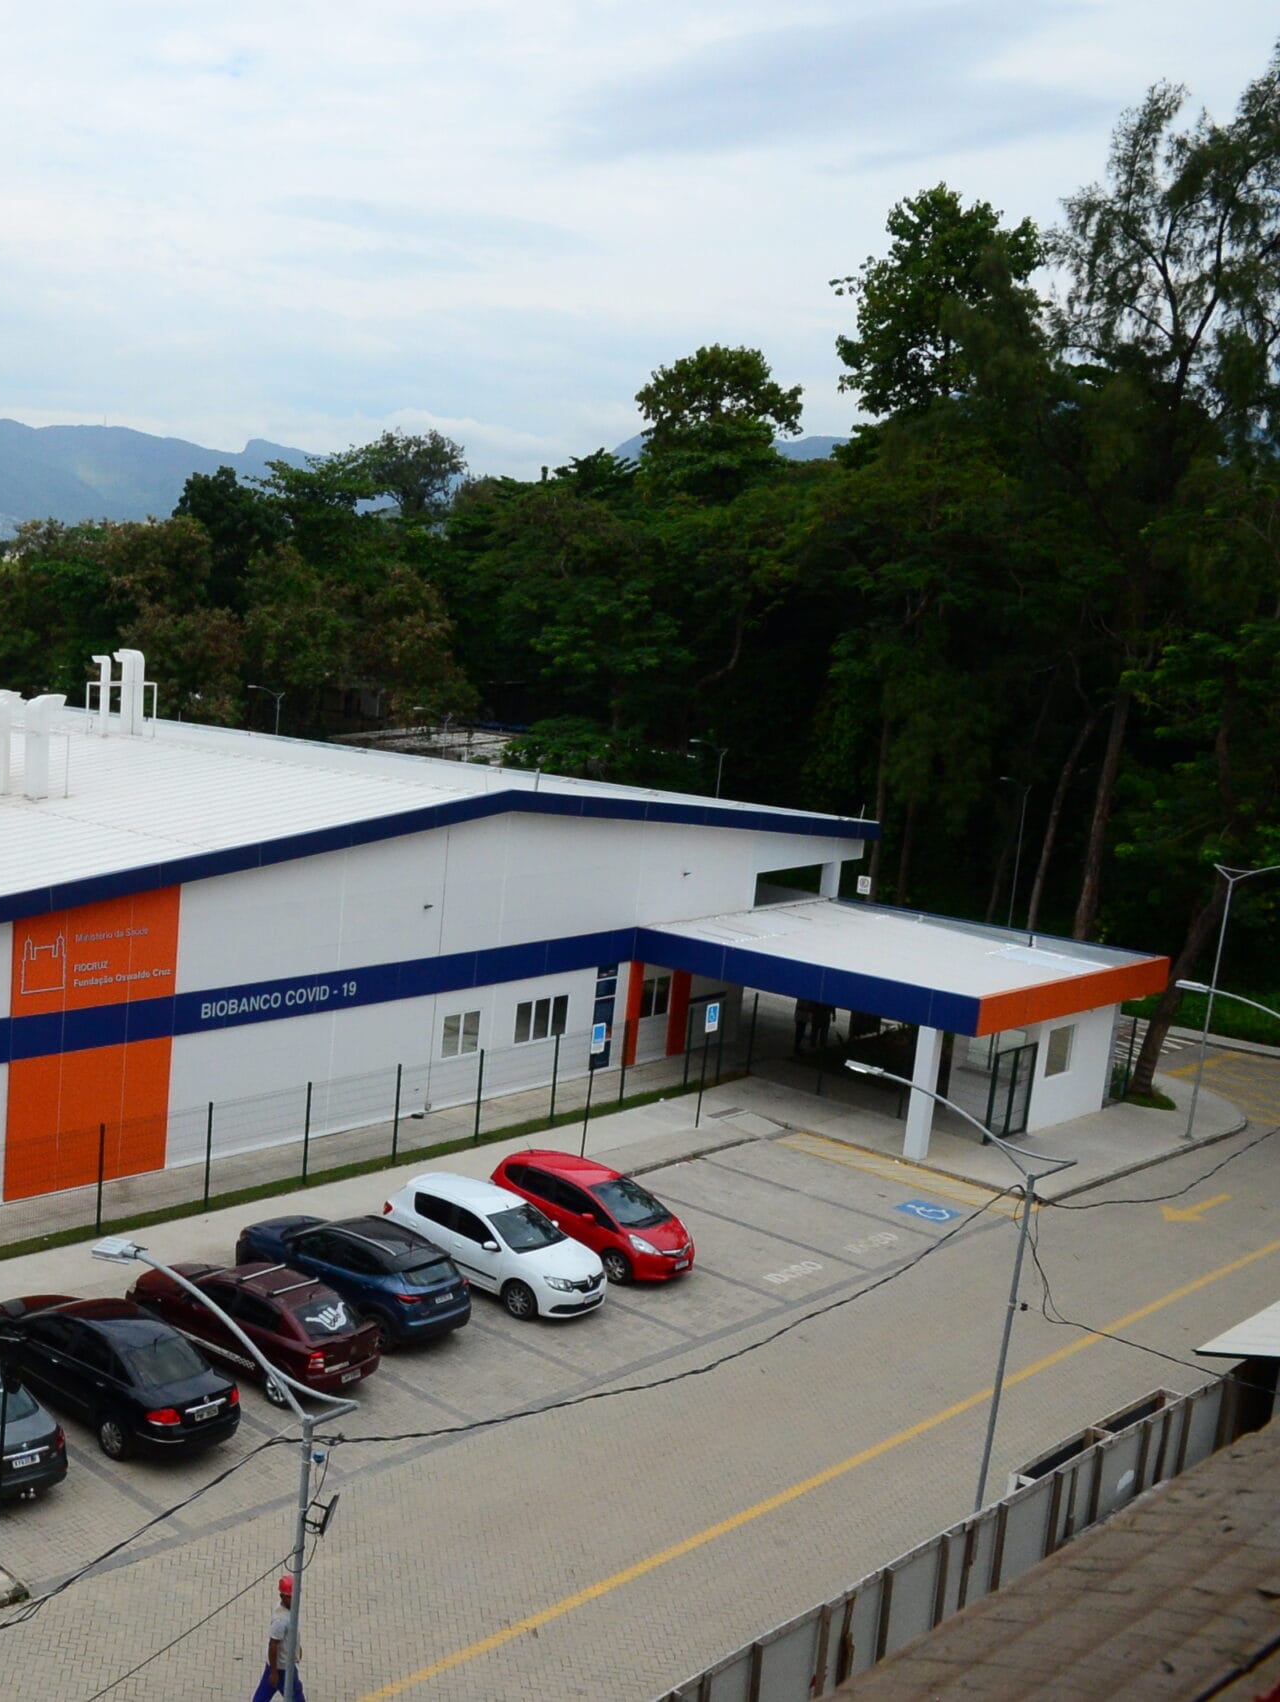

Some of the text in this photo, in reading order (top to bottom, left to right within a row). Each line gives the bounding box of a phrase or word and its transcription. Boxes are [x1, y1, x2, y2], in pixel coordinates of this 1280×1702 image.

[114, 928, 124, 938] da
[73, 960, 109, 972] FIOCRUZ
[73, 968, 171, 987] Fundação Oswaldo Cruz
[200, 992, 282, 1019] BIOBANCO
[285, 985, 330, 1006] COVID
[342, 981, 357, 997] 19
